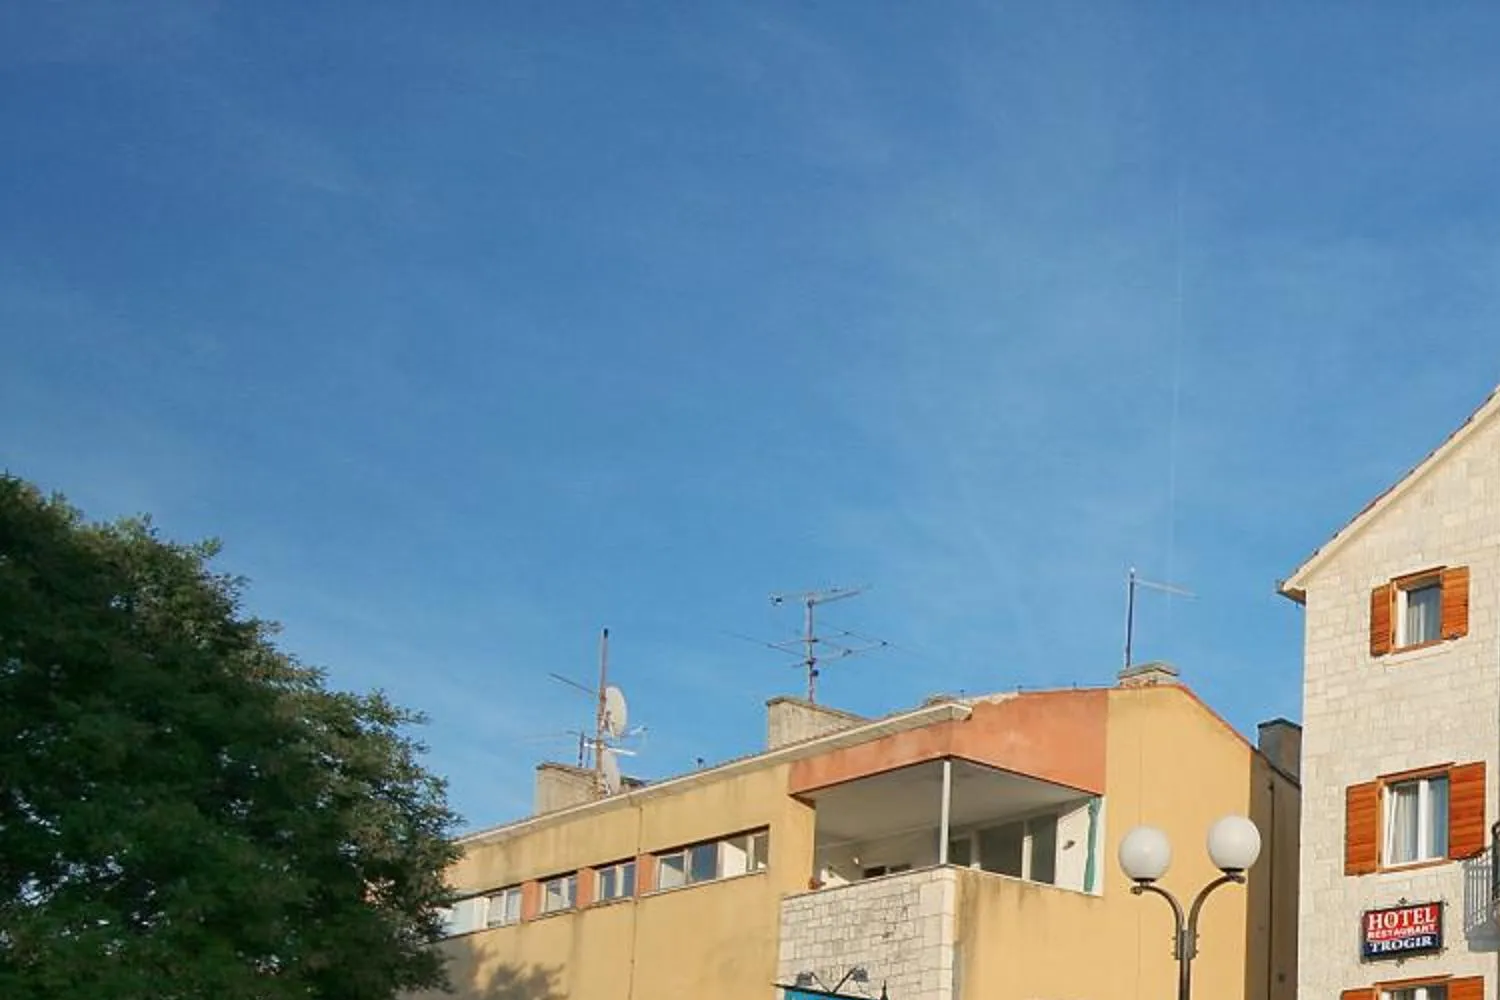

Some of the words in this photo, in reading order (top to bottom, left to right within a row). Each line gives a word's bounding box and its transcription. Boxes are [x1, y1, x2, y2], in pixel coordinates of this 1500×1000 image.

[1368, 907, 1437, 931] HOTEL
[1367, 924, 1436, 939] RESTAURANT
[1370, 935, 1432, 953] TROGIR
